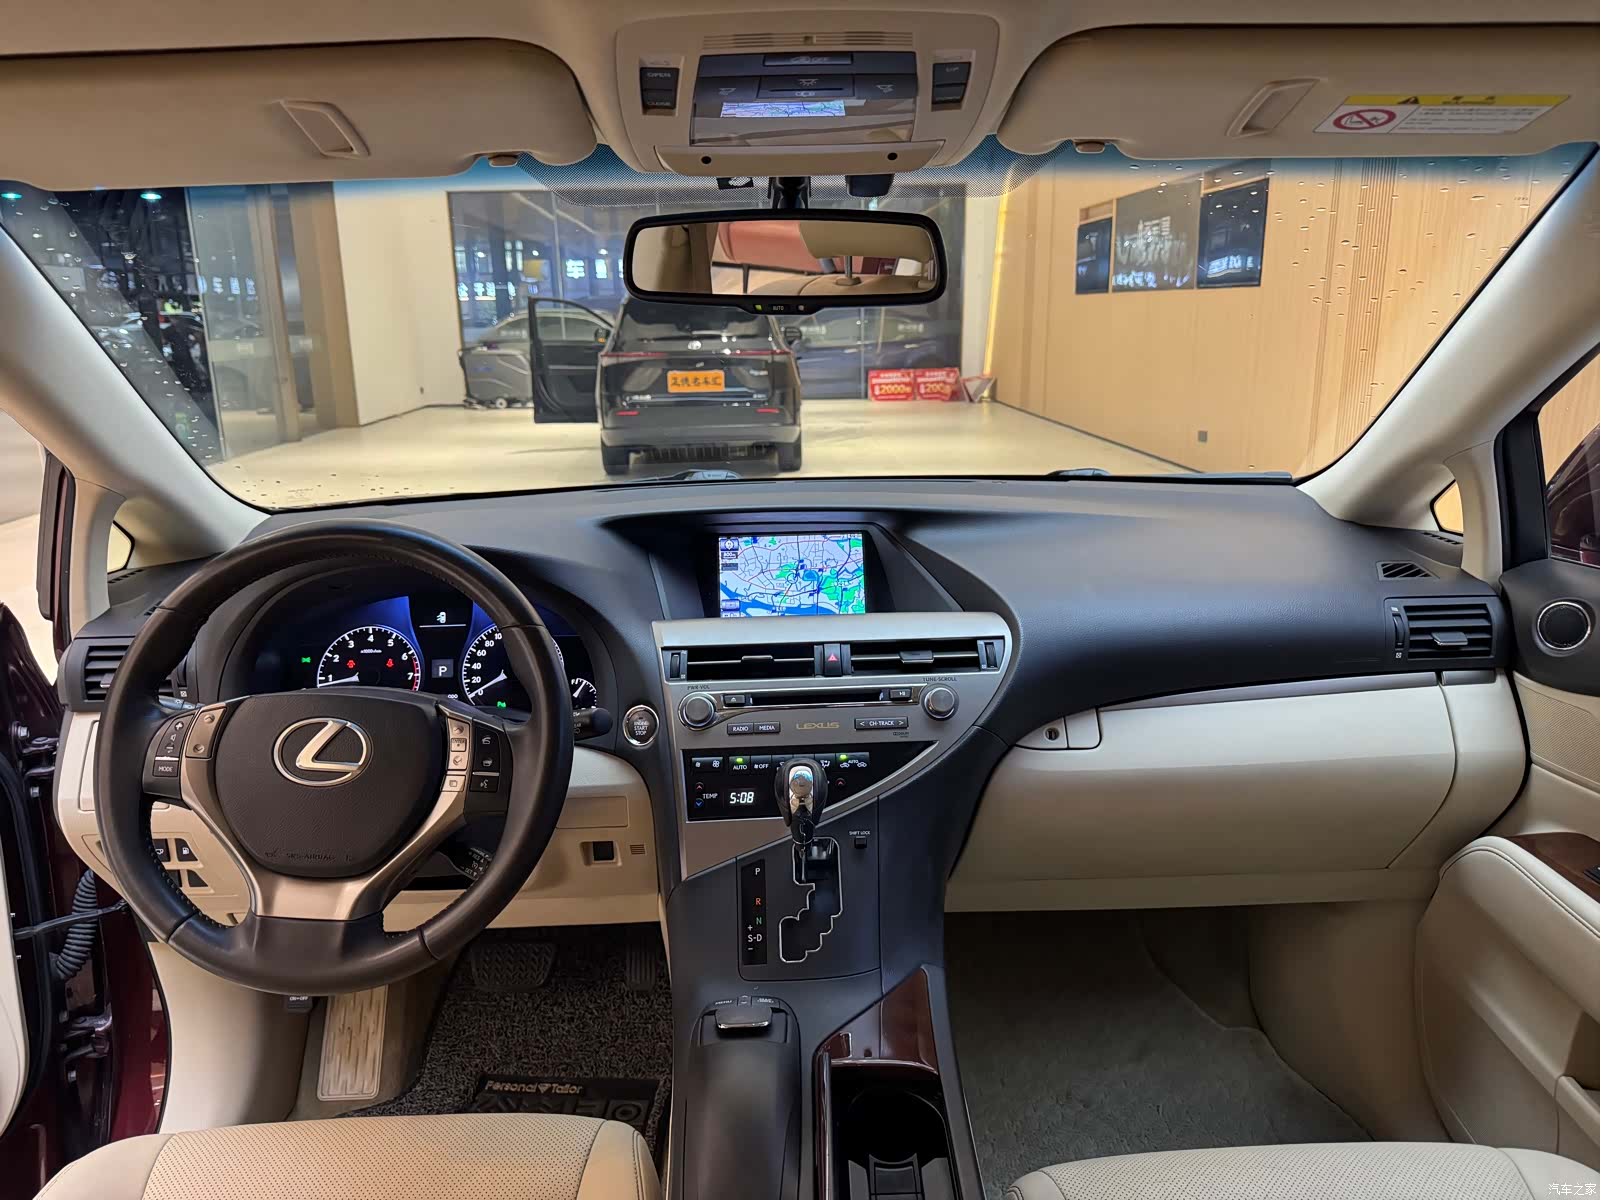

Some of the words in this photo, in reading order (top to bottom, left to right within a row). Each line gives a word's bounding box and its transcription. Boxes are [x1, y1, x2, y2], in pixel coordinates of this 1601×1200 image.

[367, 634, 375, 642] 4
[494, 632, 503, 640] 10
[347, 640, 355, 648] 3
[387, 638, 394, 647] 5
[401, 652, 408, 661] 6
[476, 649, 487, 657] 60
[332, 654, 340, 662] 2
[471, 662, 482, 670] 40
[438, 666, 448, 677] P
[407, 672, 414, 680] 7
[795, 722, 840, 730] LEXUS
[729, 791, 755, 804] 5:08
[755, 867, 761, 875] P
[756, 916, 762, 924] N
[747, 933, 763, 943] S-D
[485, 1080, 537, 1092] Personal
[551, 1083, 584, 1094] Tailor
